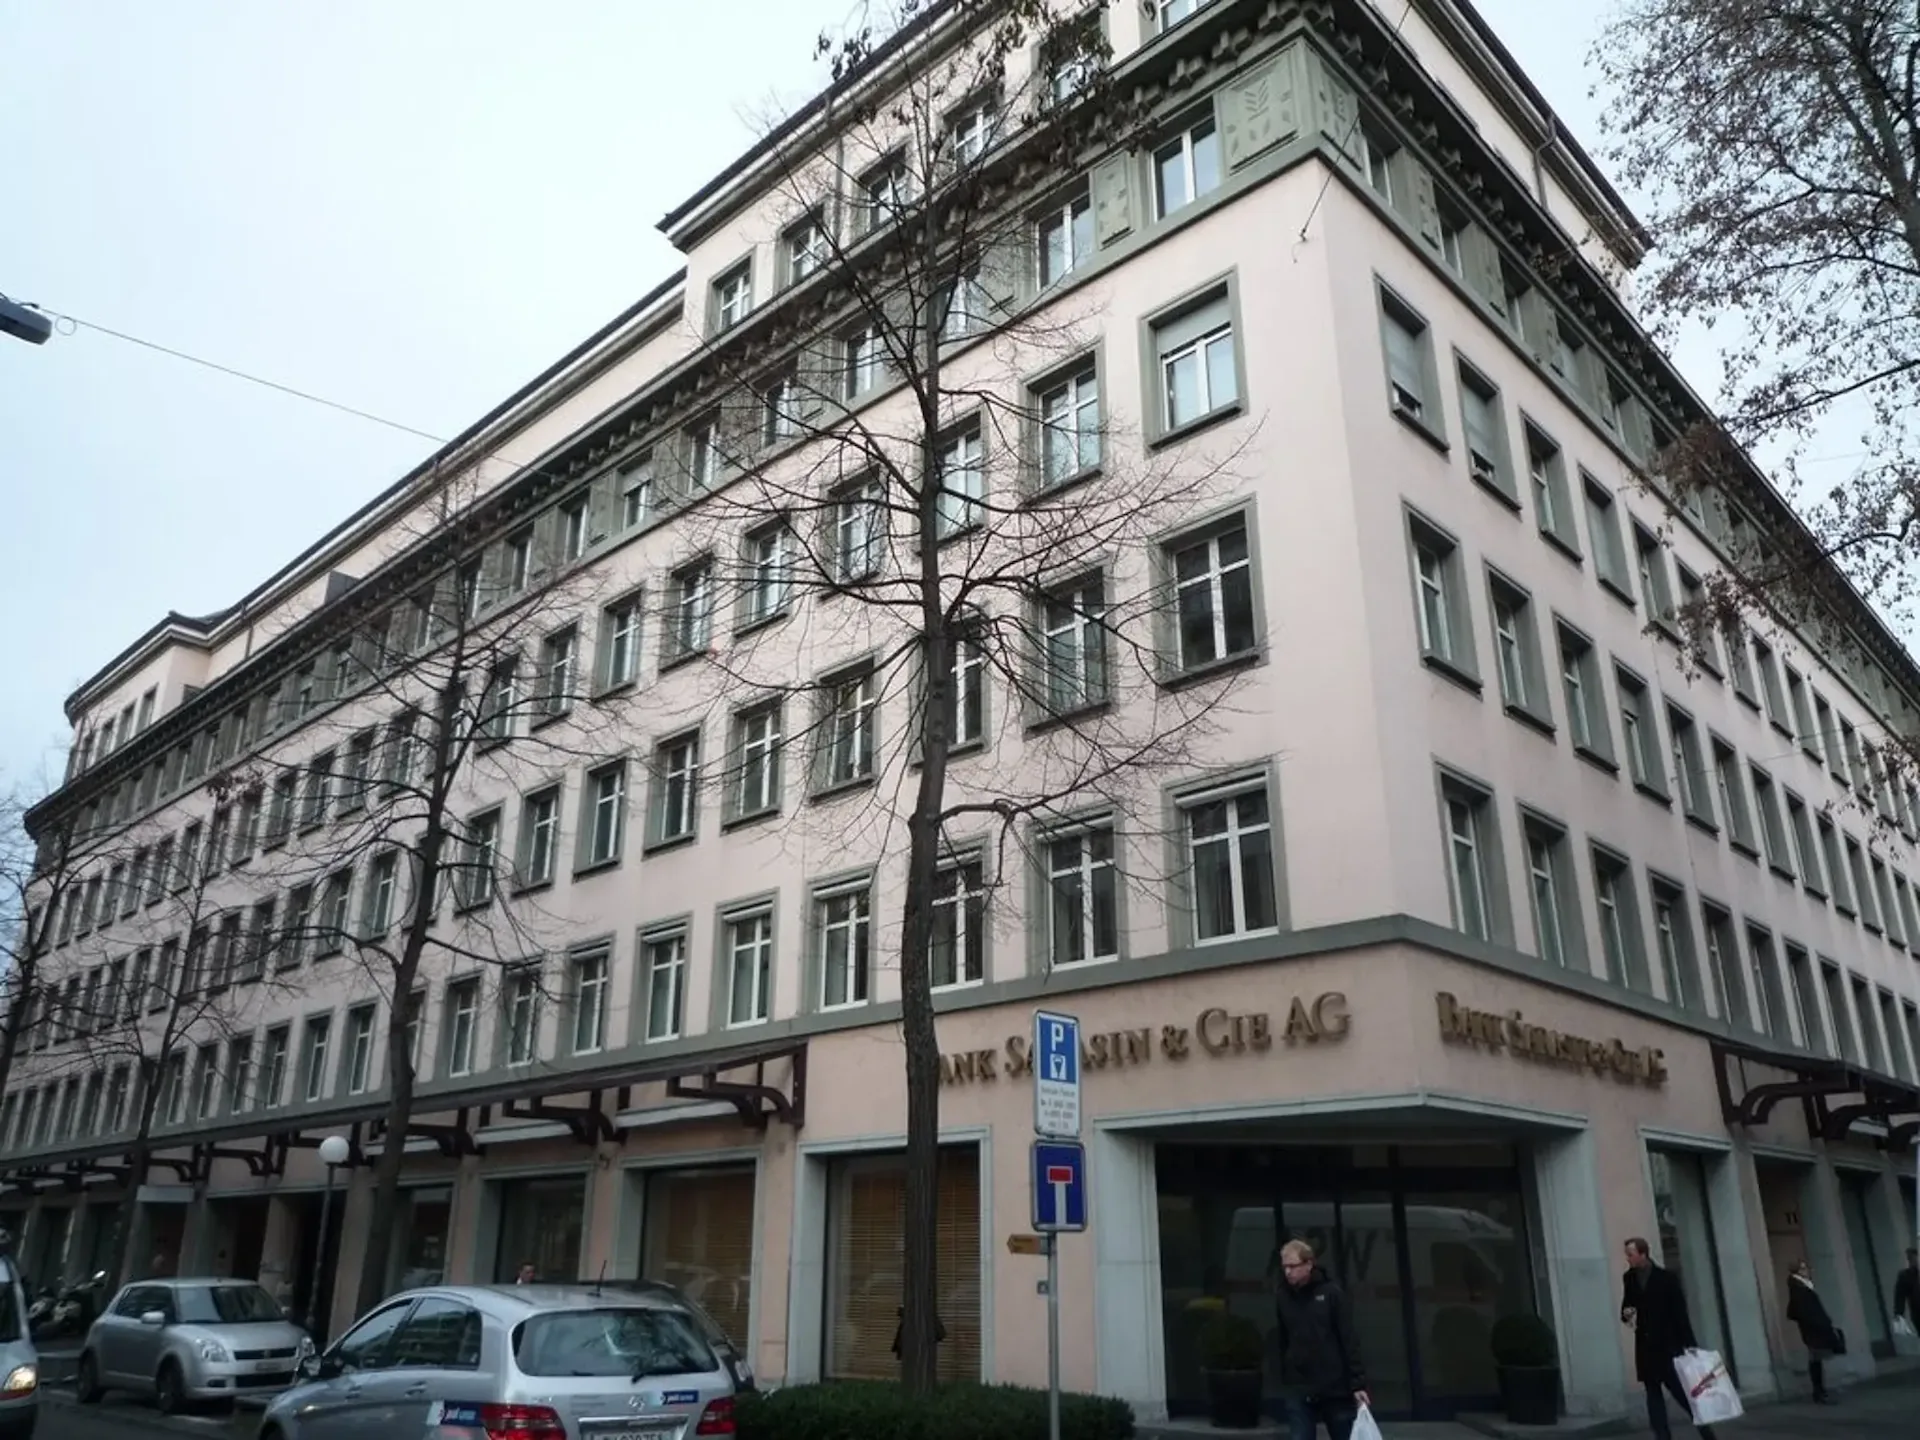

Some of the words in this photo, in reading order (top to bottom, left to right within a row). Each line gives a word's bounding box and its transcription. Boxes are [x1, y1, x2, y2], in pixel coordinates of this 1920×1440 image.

[938, 1049, 997, 1086] ANK
[1160, 1024, 1190, 1060] &
[1281, 992, 1352, 1044] AG
[1051, 1022, 1064, 1052] P
